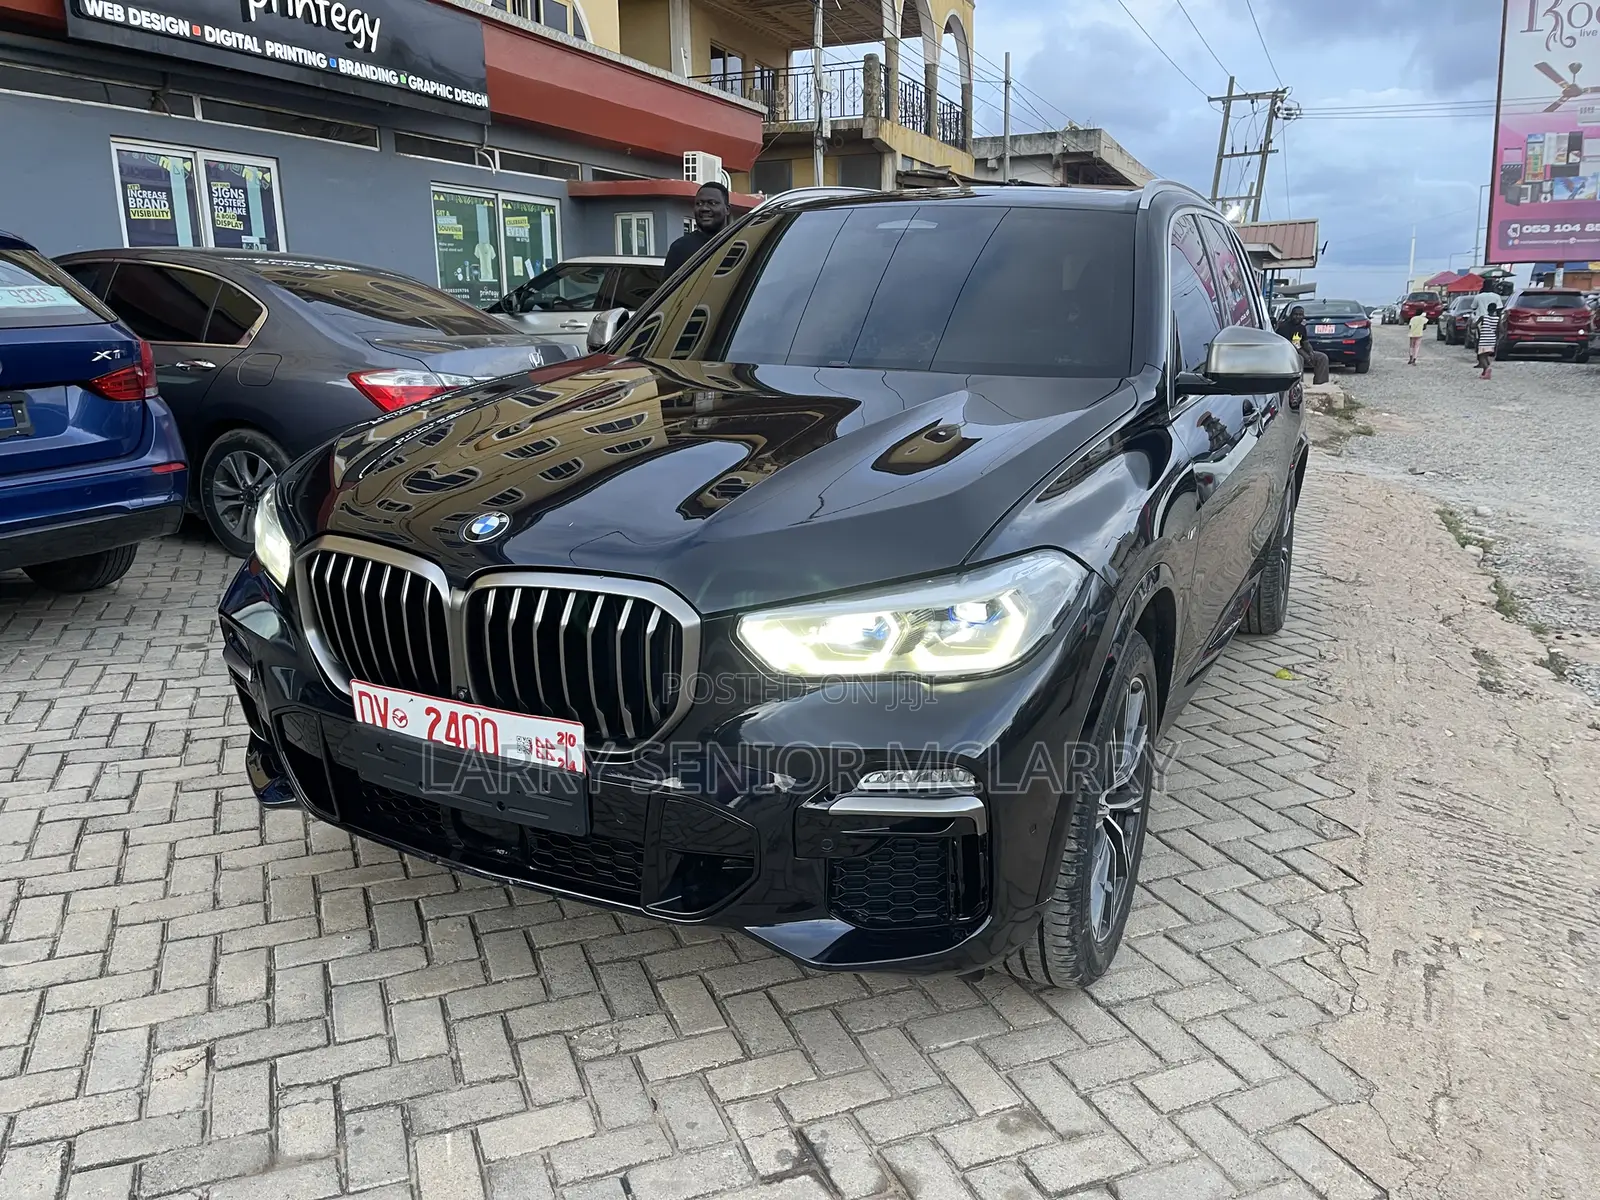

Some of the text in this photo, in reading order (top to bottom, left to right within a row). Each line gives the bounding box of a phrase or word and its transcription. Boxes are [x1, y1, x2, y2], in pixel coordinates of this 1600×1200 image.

[1520, 0, 1600, 52] Ro
[1580, 29, 1598, 37] live
[84, 0, 488, 108] WEB DESIGN DIGITAL PRINTING BRANDING GRAPHIC DESIGN
[127, 189, 167, 200] INCREASE
[212, 187, 244, 199] SIGNS
[128, 198, 169, 210] BRAND
[213, 197, 246, 207] POSTERS
[130, 210, 170, 218] VISIBILITY
[226, 206, 247, 215] MAKE
[216, 219, 243, 229] DISPLAY
[1522, 224, 1551, 233] 053
[1554, 223, 1581, 232] 104
[358, 690, 499, 756] DV 2400
